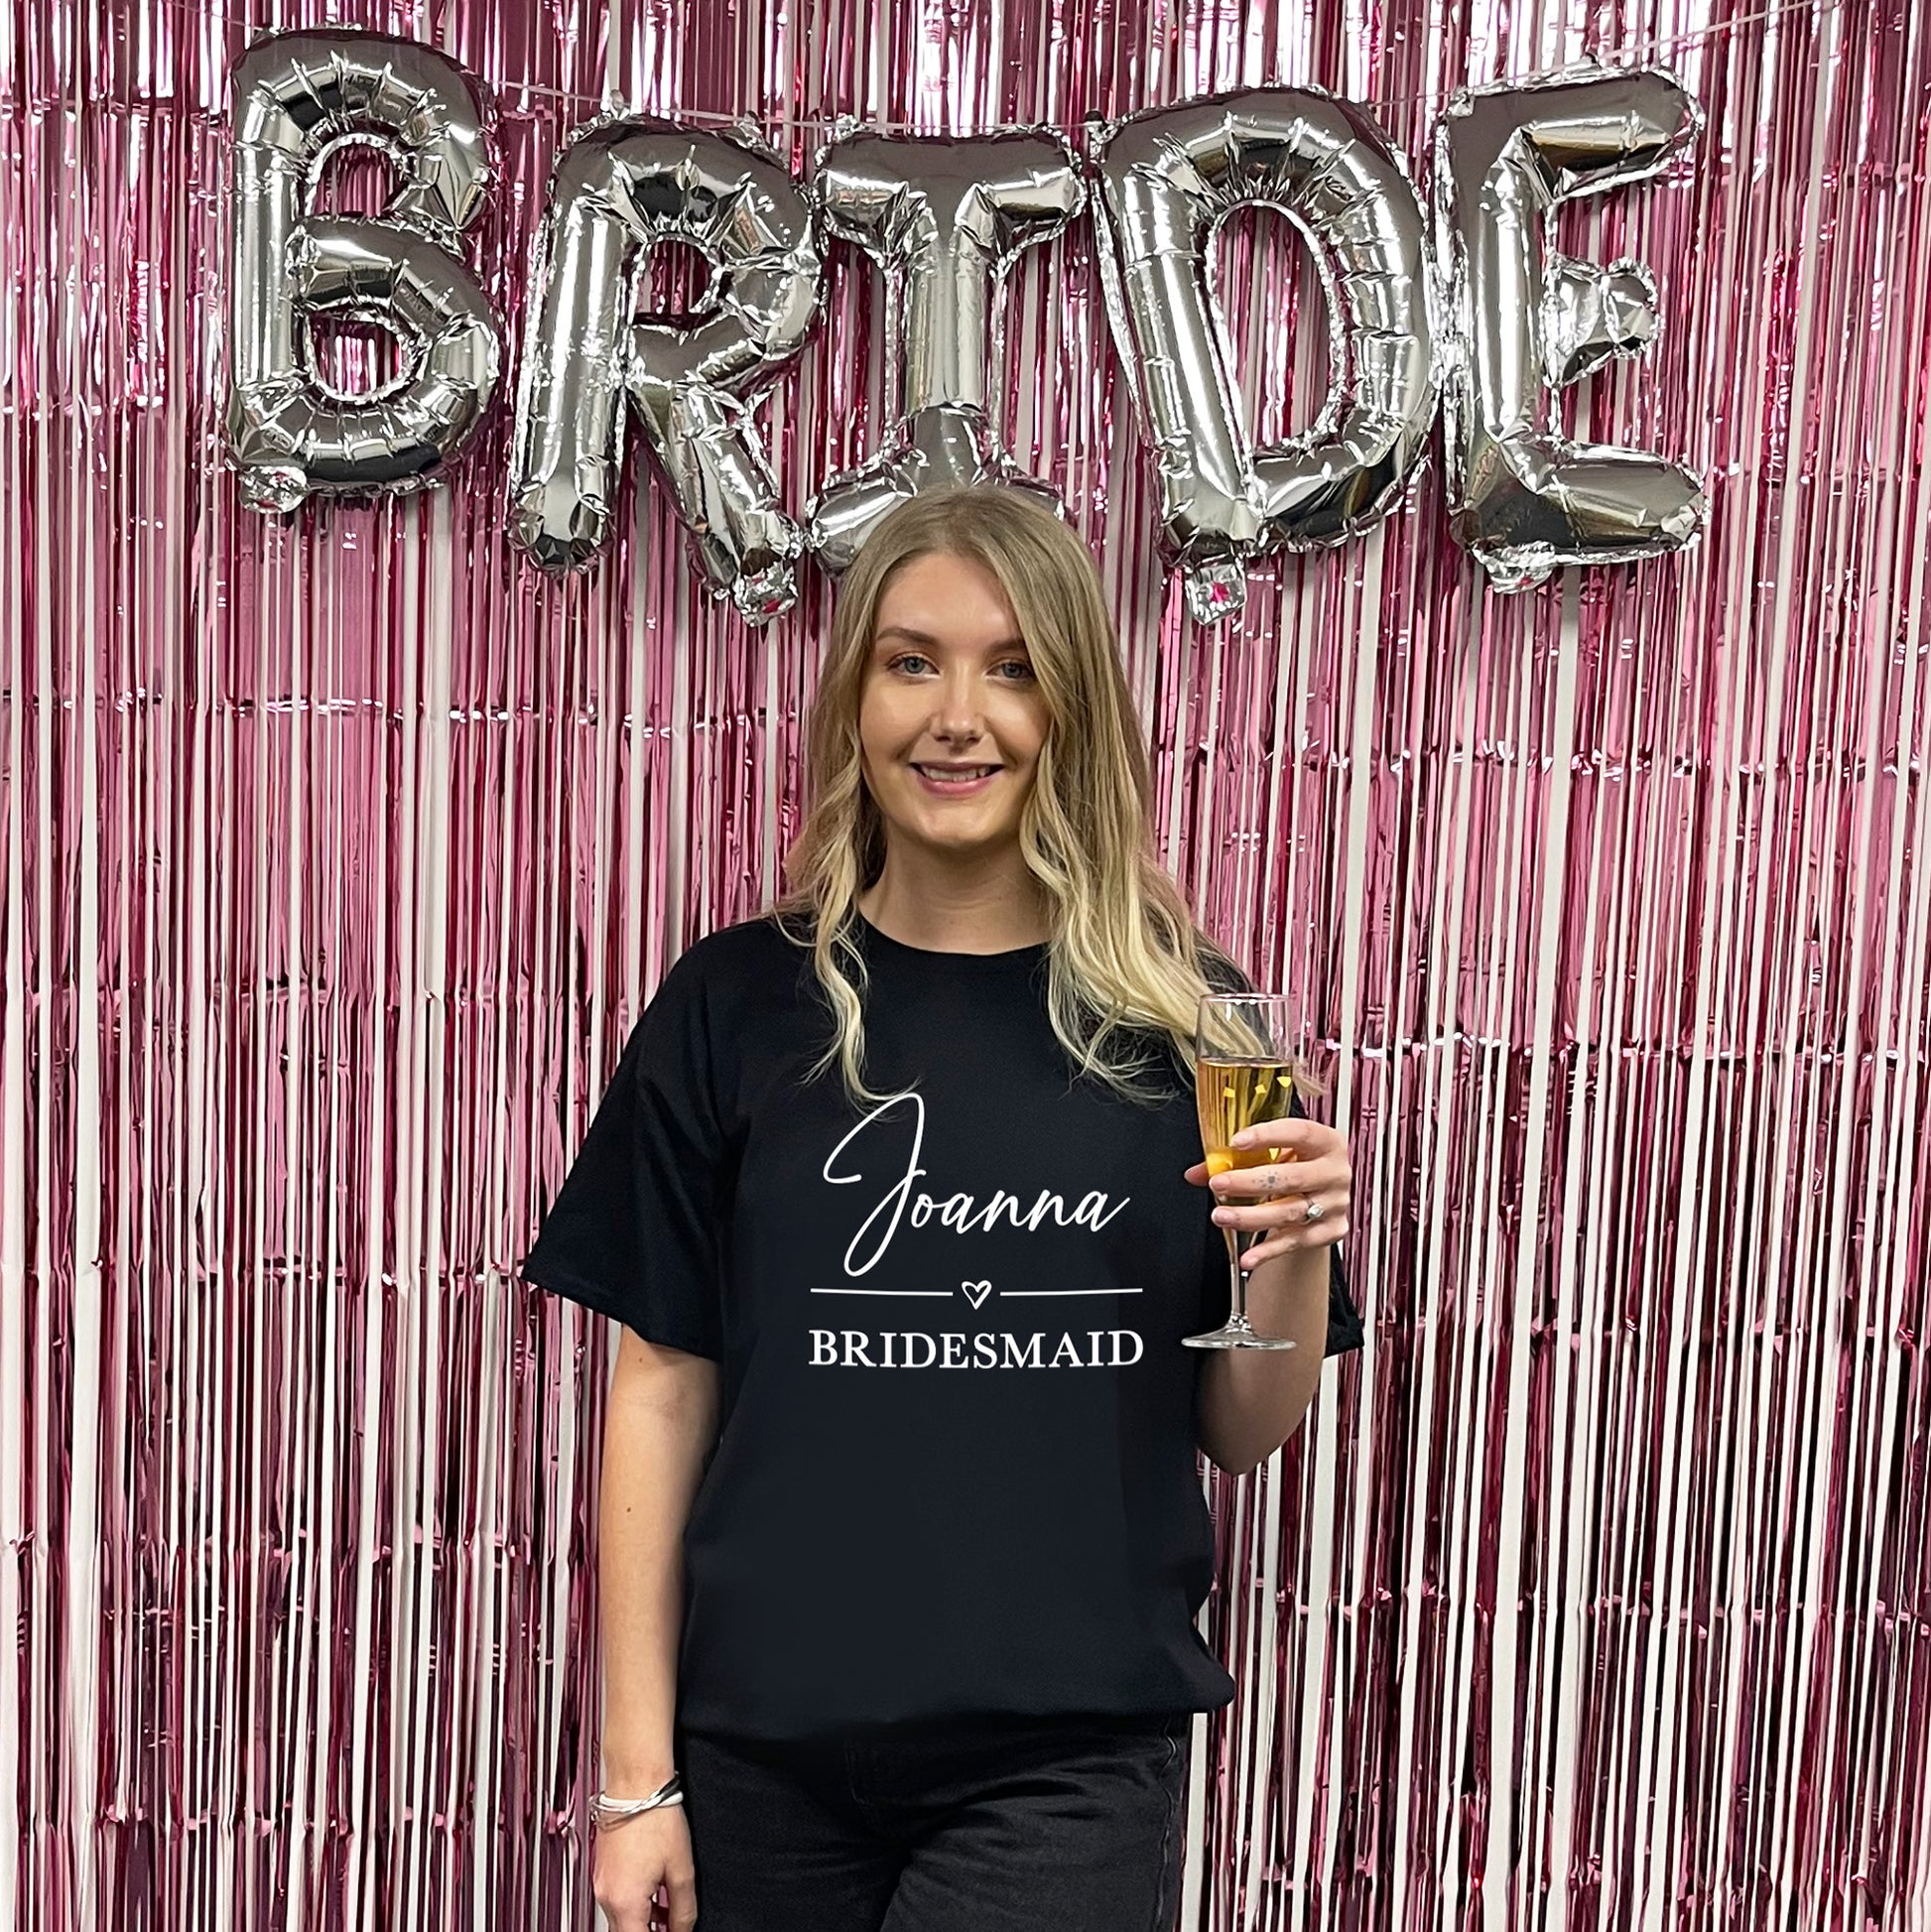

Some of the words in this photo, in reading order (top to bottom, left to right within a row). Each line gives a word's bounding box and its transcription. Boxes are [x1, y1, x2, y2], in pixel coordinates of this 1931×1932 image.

[223, 26, 1711, 625] BRIDE
[823, 1093, 1130, 1277] Joanna
[809, 1329, 1144, 1369] BRIDESMAID
